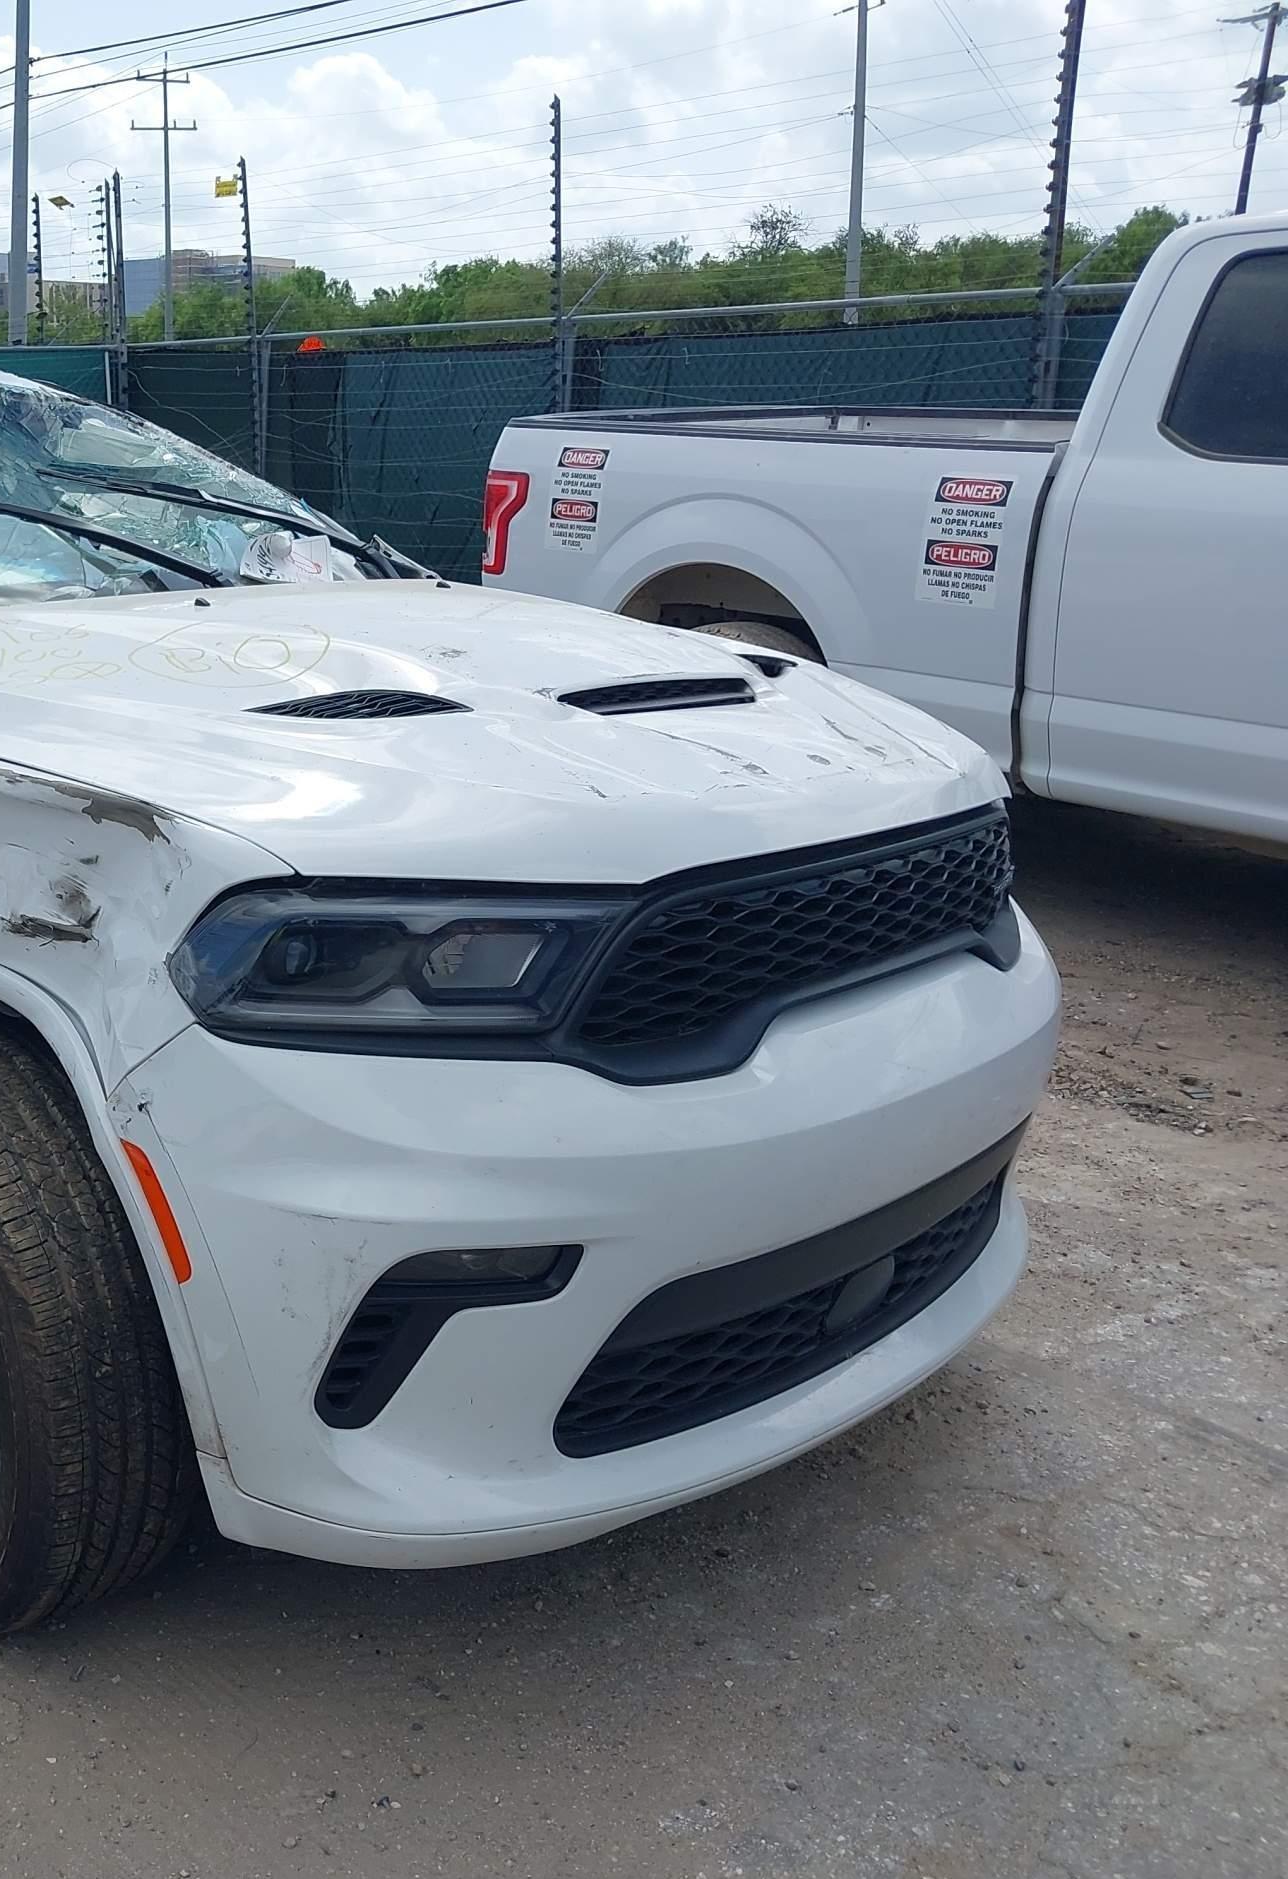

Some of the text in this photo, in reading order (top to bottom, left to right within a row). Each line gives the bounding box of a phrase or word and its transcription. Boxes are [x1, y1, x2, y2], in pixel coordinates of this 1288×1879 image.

[564, 451, 603, 465] DANGER
[944, 483, 1004, 500] DANGER
[555, 504, 593, 517] PELIGRO
[941, 508, 996, 519] NO SMOKING
[930, 517, 1003, 530] NO OPEN FLAMES
[941, 527, 989, 539] NO SPARKS
[933, 547, 989, 564] PELIGRO
[923, 568, 994, 583] NO FUMAR NO PRODUCIR
[927, 578, 950, 587] LLAMAS
[960, 582, 986, 592] CHISPAS
[950, 591, 970, 600] FUEGO
